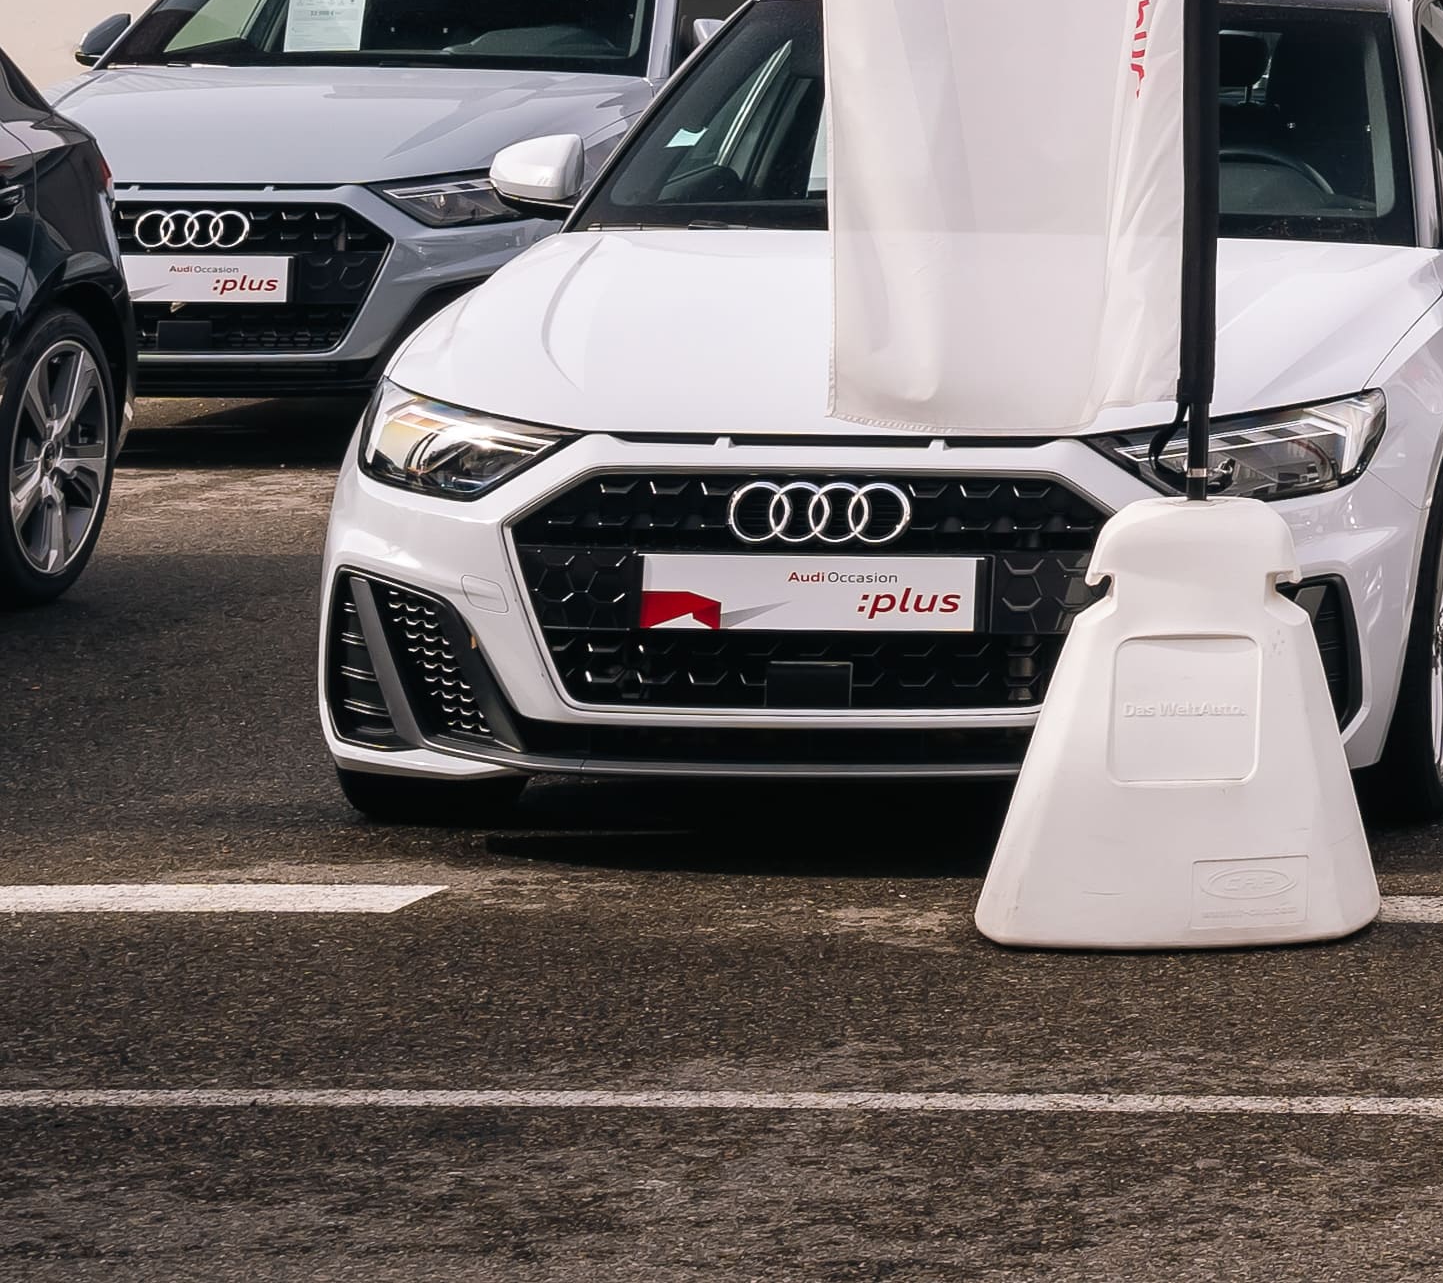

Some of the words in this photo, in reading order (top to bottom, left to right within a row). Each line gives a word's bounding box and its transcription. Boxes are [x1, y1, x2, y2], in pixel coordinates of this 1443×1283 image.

[168, 265, 193, 273] Audi
[193, 265, 240, 274] Occasion
[212, 274, 279, 295] :plus
[787, 571, 825, 584] Audi
[827, 571, 898, 584] Occasion
[856, 587, 962, 620] :plus
[1122, 701, 1155, 718] Das
